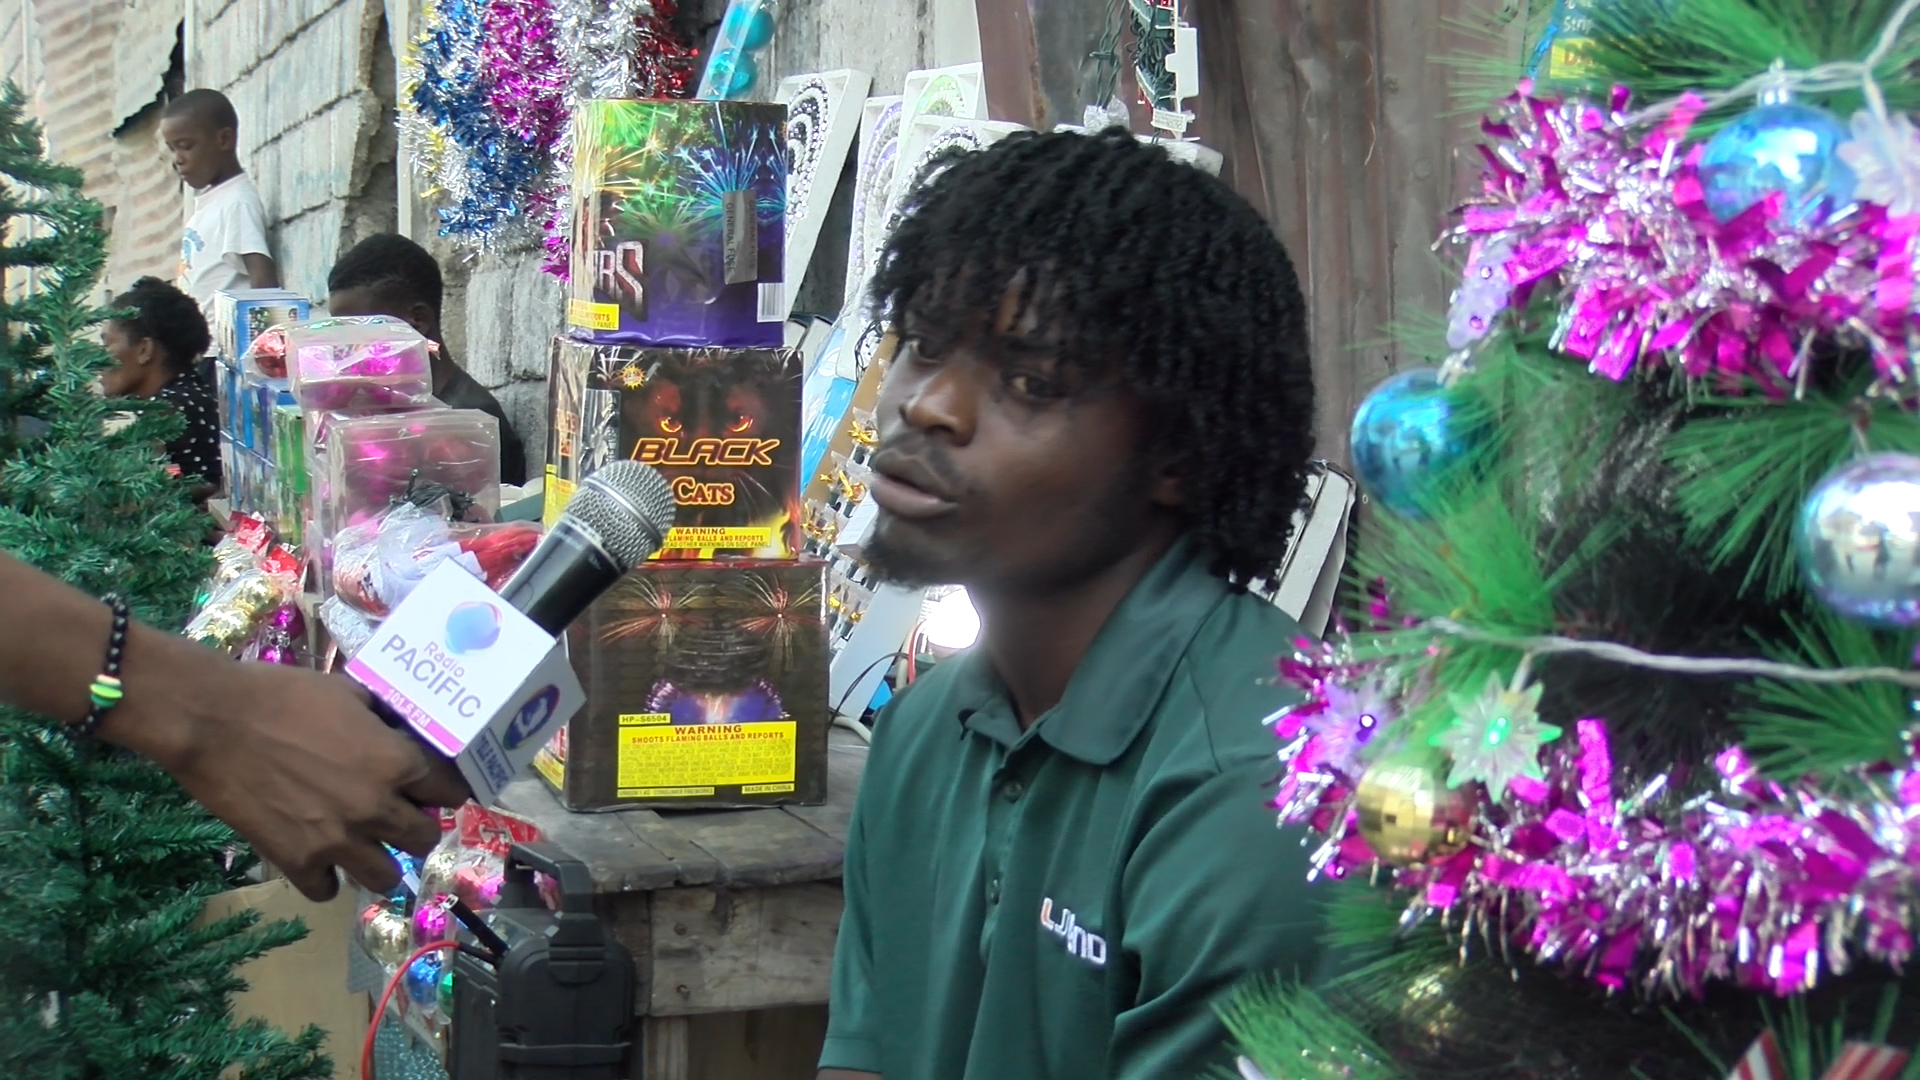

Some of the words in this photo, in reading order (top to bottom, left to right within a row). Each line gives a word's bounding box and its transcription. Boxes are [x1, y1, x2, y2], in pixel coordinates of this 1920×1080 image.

[630, 438, 780, 465] BLACK
[424, 641, 465, 677] Radio
[381, 634, 481, 718] PACIFIC
[410, 709, 431, 728] FM
[675, 724, 742, 734] WARNING
